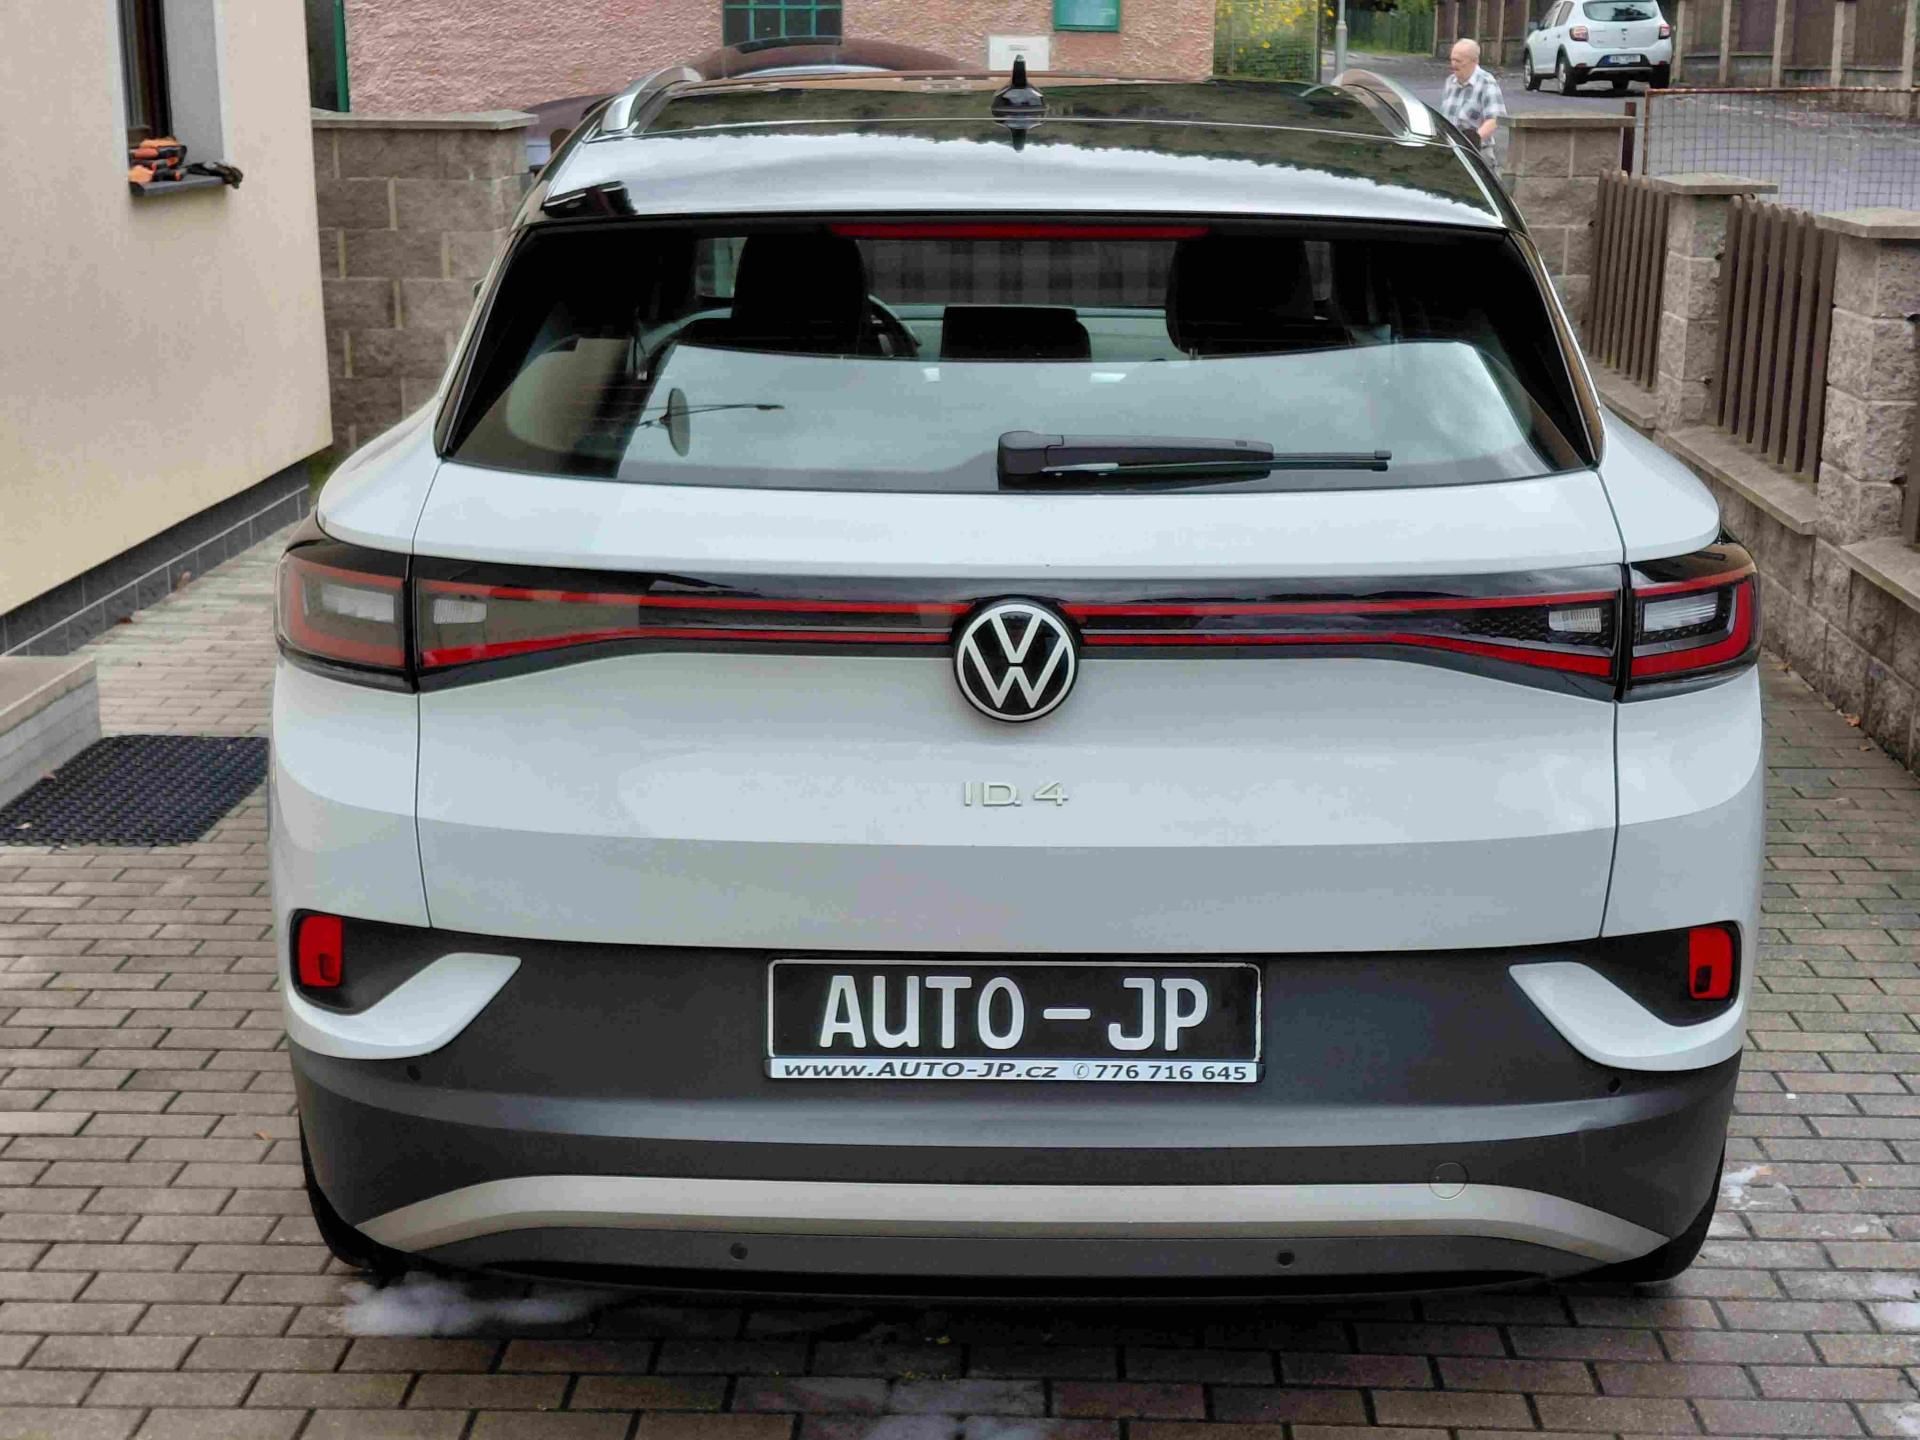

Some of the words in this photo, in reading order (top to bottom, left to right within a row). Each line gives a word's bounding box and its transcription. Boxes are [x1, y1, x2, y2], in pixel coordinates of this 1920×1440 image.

[957, 604, 1075, 721] VW
[784, 1061, 1058, 1079] www.AUTO-JP.cz
[1094, 1064, 1140, 1080] 776
[1148, 1065, 1193, 1081] 716
[1201, 1065, 1247, 1081] 645
